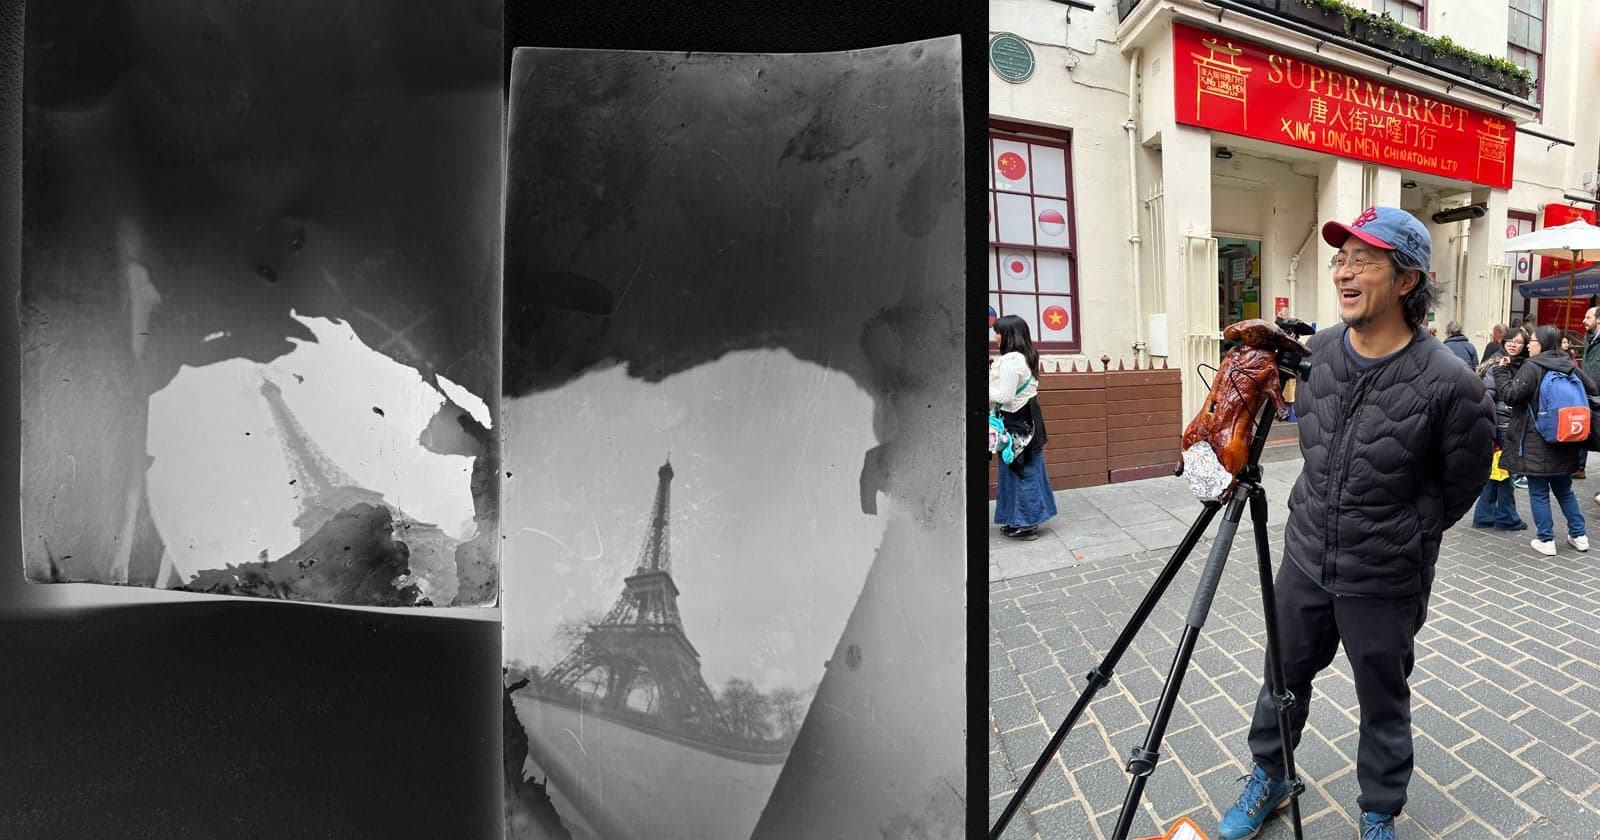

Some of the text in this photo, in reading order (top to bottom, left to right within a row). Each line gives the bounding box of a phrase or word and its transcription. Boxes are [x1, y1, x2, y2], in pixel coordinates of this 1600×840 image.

[1268, 54, 1469, 133] SUPERMARKET
[1280, 117, 1459, 172] XING LONG MEN CHINATOWN LTD
[1309, 96, 1438, 151] 唐人街兴隆门行
